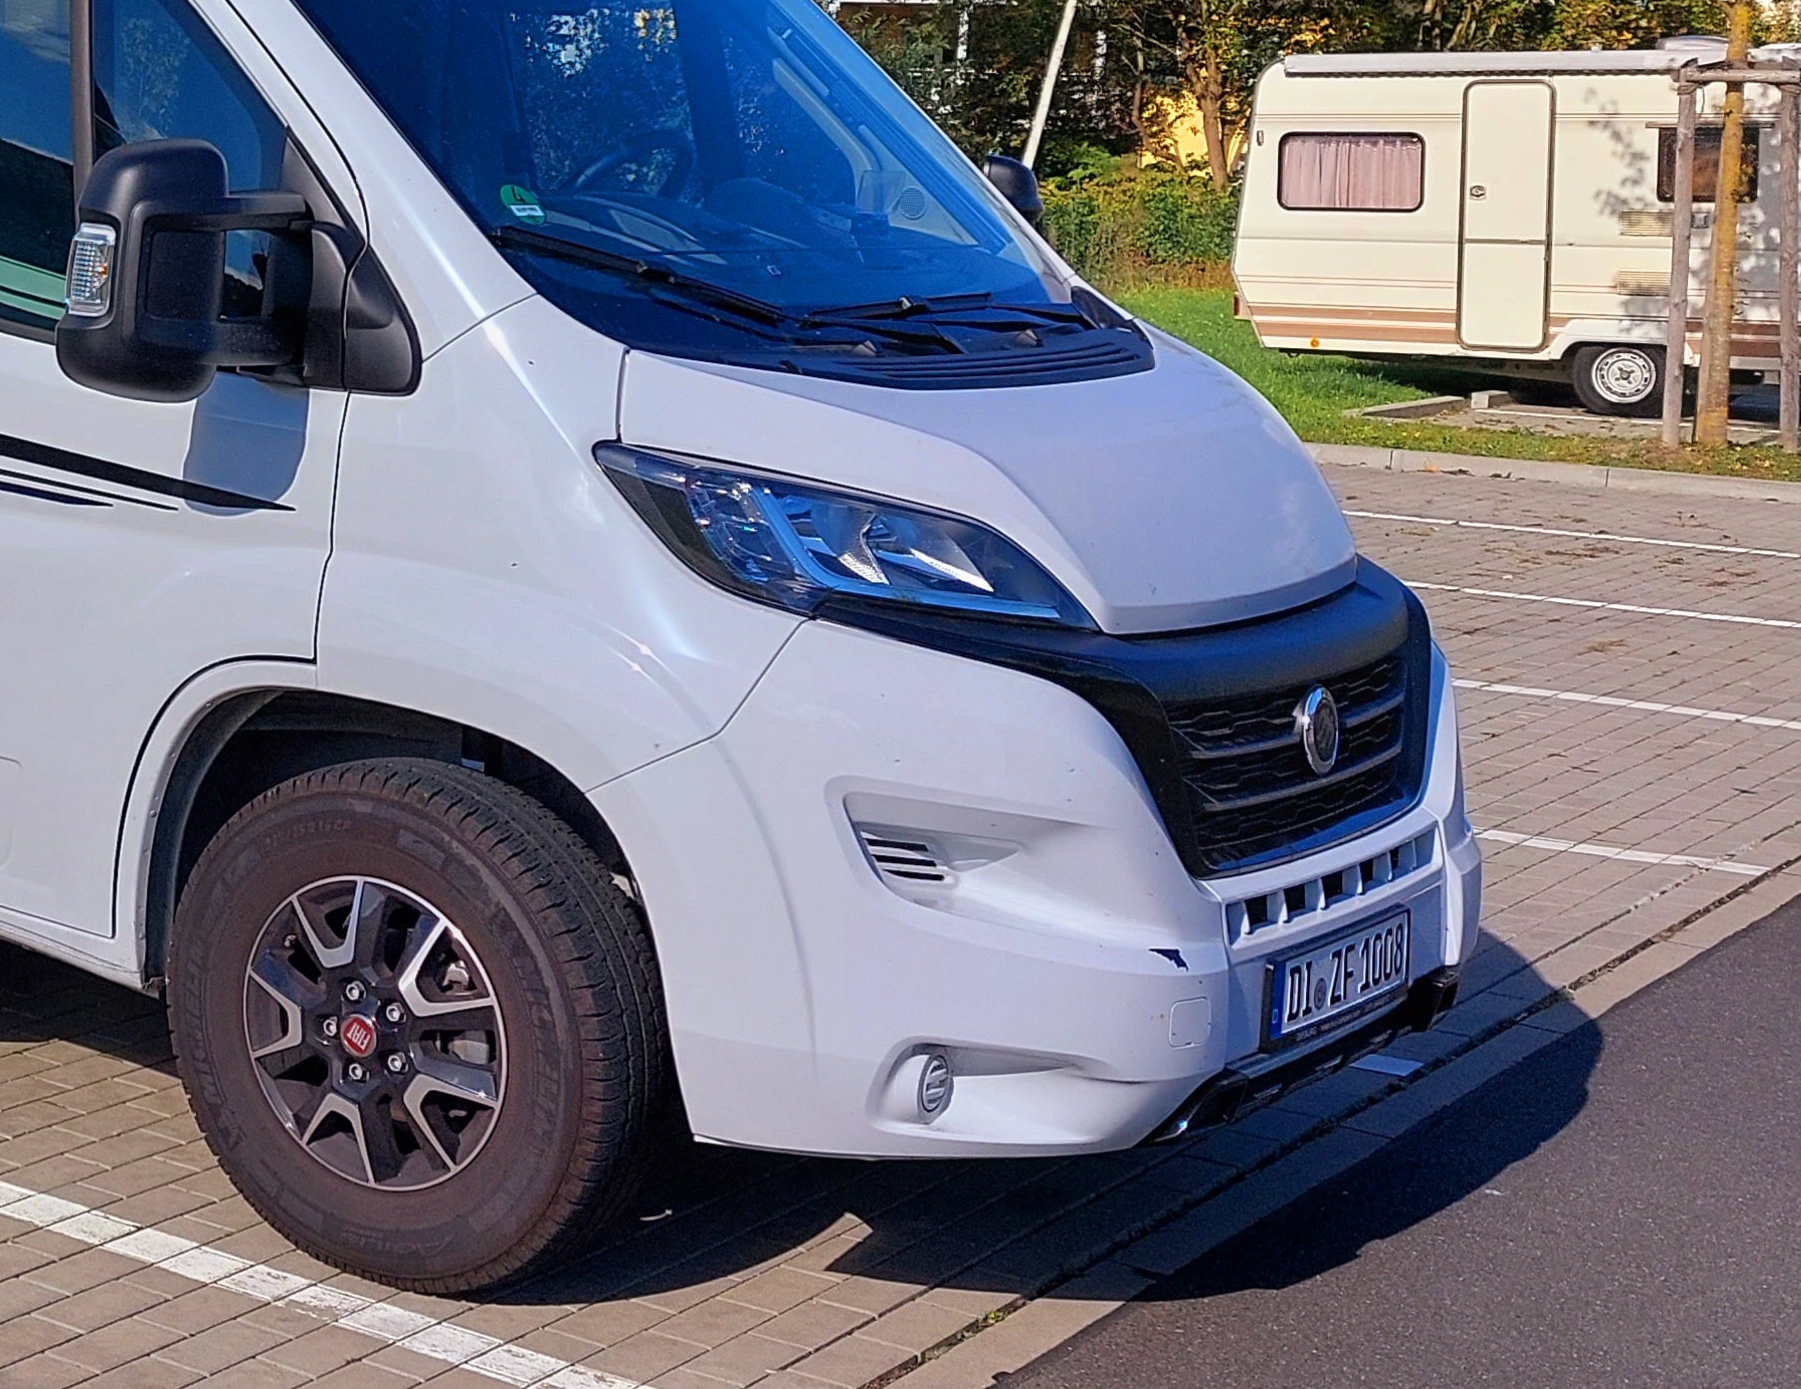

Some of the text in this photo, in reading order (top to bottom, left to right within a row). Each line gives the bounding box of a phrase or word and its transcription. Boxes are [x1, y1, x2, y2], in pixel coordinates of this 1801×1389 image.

[510, 186, 526, 205] 4
[1285, 961, 1313, 1023] DI
[1328, 943, 1357, 1007] ZF
[1359, 923, 1404, 993] 1008
[346, 1022, 371, 1051] FIAT
